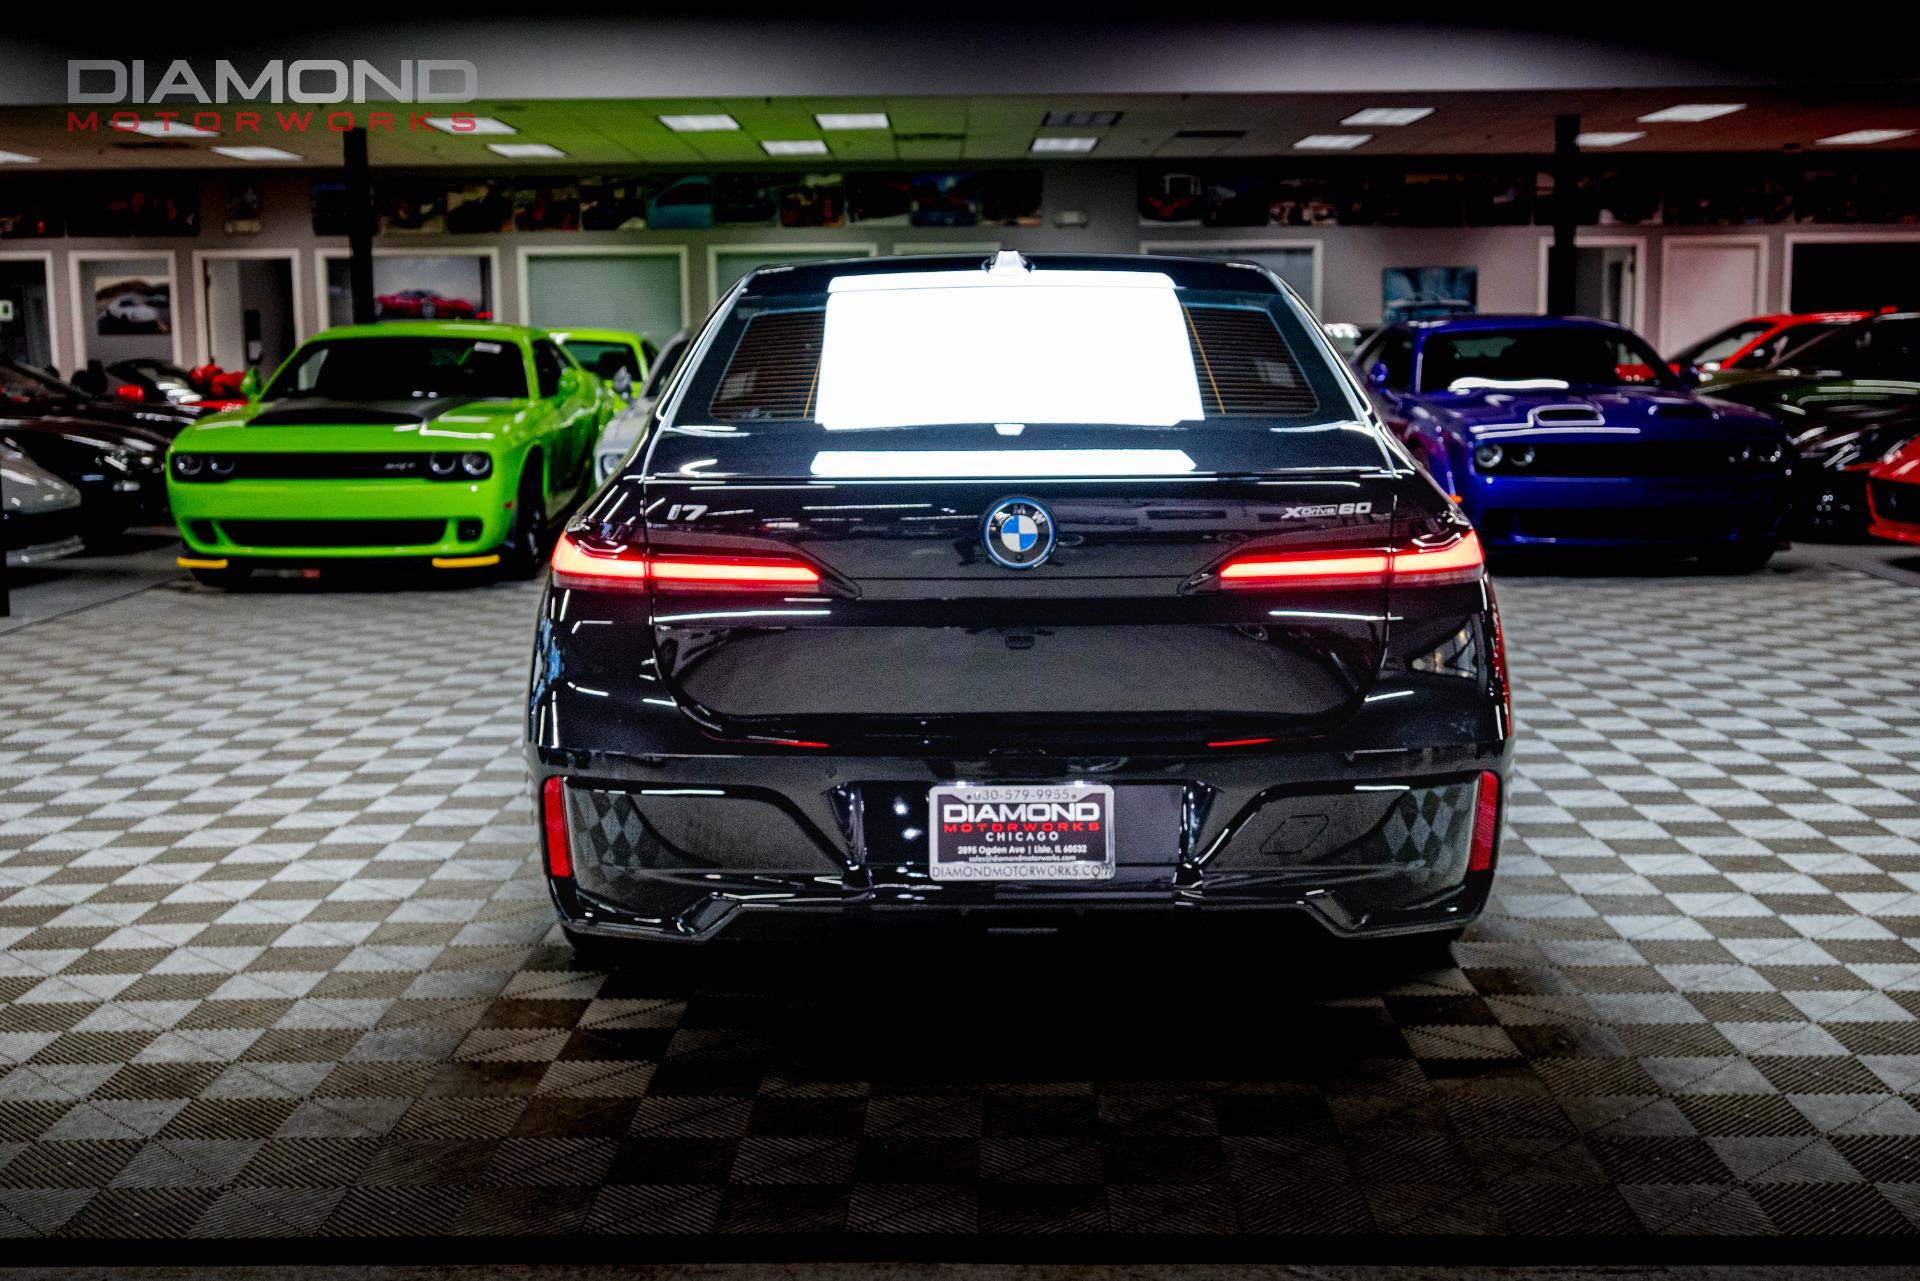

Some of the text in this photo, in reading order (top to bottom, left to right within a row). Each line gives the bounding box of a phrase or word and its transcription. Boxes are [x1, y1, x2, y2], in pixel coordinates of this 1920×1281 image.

[995, 504, 1046, 526] BMW
[973, 789, 1070, 800] 630-579-9955
[943, 803, 1100, 823] DIAMOND
[943, 822, 1100, 833] MOTORWORKS
[985, 831, 1060, 842] CHICAGO
[978, 845, 1006, 855] Ogden
[1008, 845, 1026, 854] Ave
